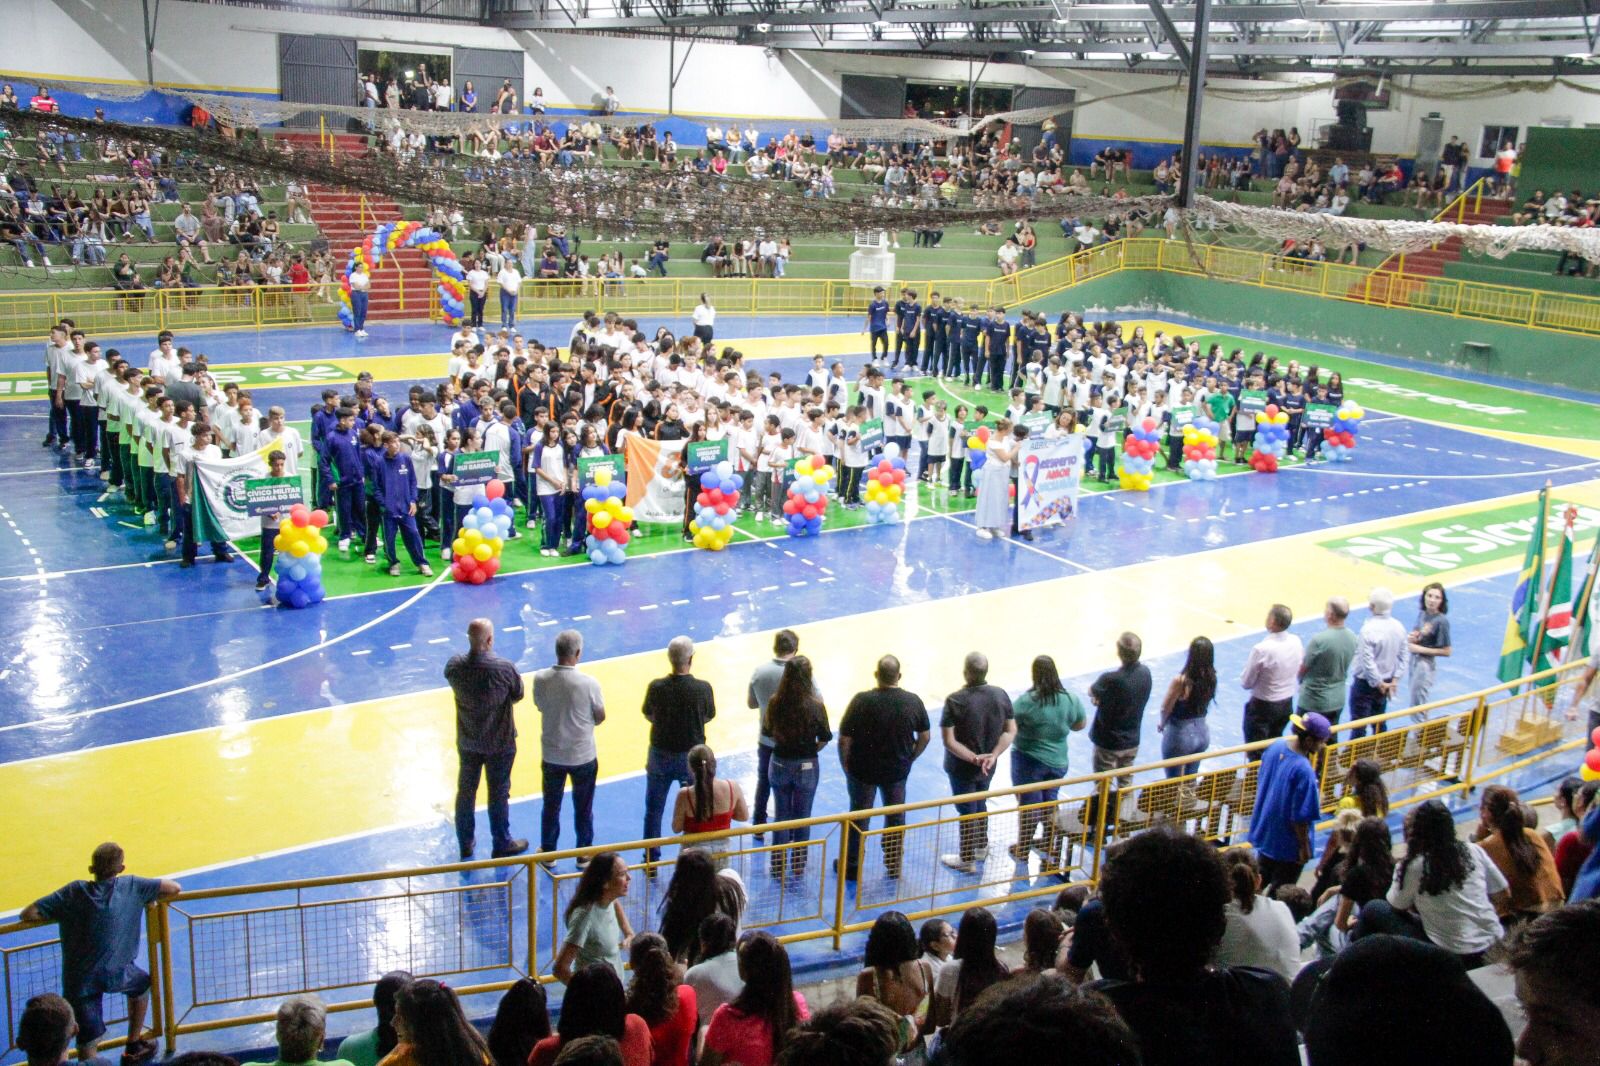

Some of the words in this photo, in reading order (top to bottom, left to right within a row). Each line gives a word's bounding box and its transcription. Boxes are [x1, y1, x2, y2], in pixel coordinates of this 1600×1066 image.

[1045, 467, 1070, 480] AMOR
[247, 489, 272, 497] CÍVICO
[273, 487, 300, 495] MILITAR
